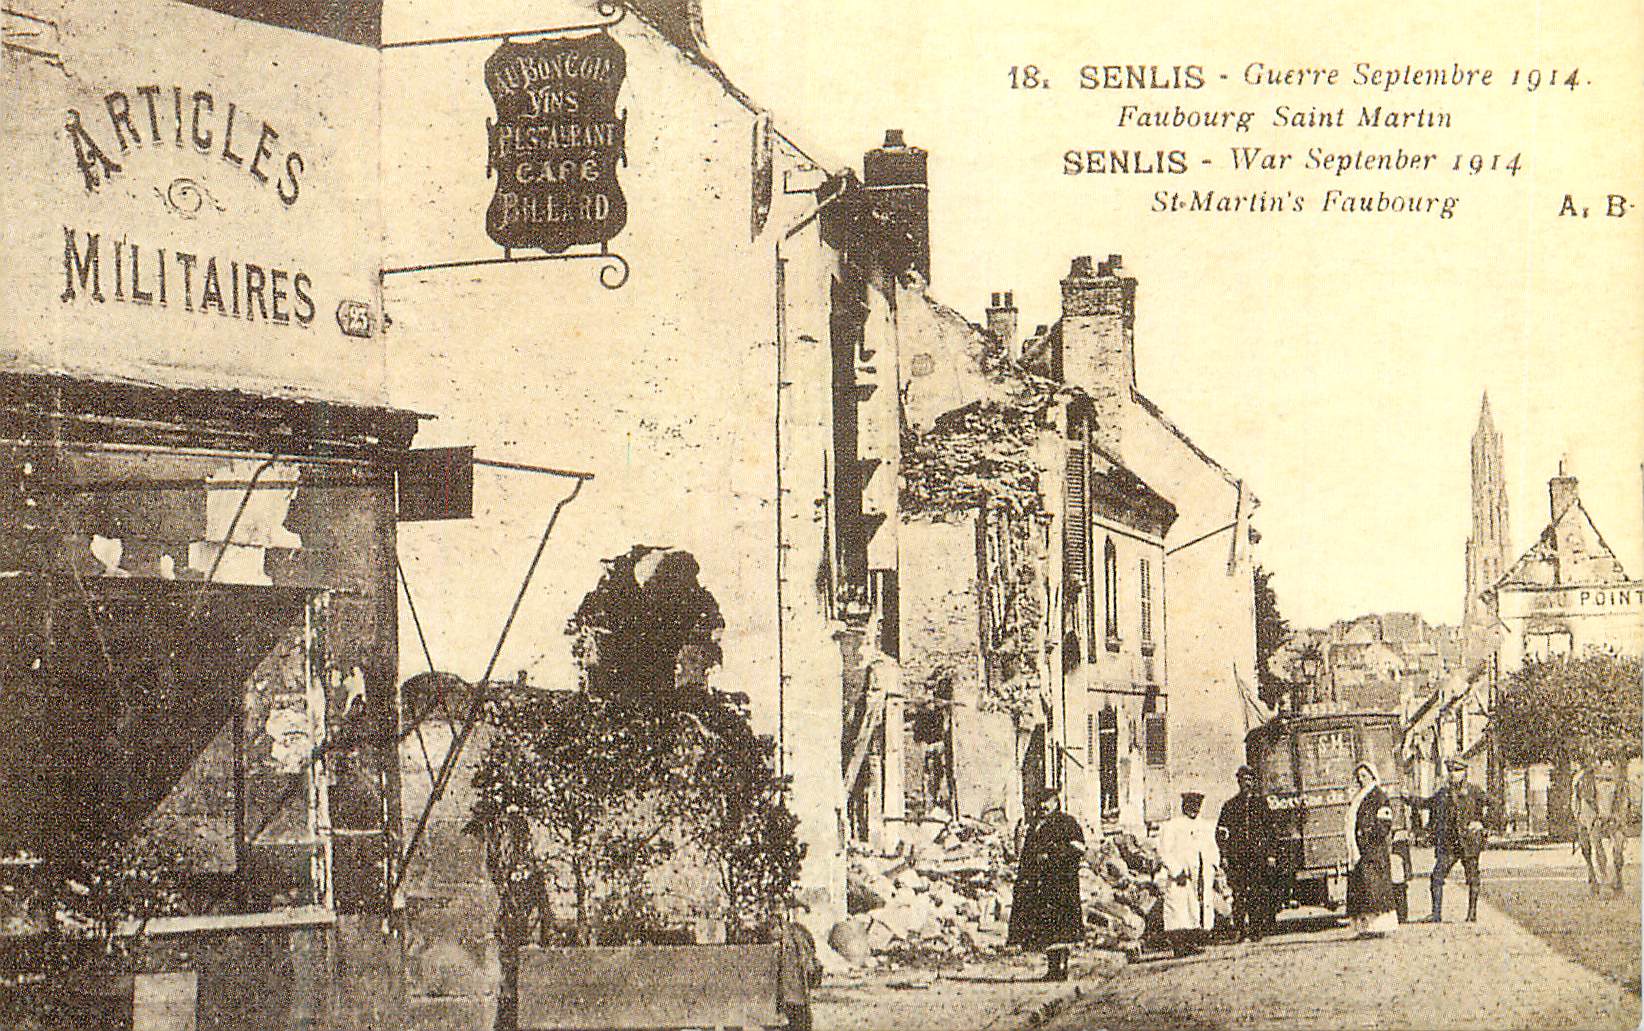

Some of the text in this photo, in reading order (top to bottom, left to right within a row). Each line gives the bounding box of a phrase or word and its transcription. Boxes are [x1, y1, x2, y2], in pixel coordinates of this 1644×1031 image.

[517, 85, 579, 118] VINS
[63, 84, 306, 207] ARTICLES
[494, 189, 610, 230] BILLARD
[59, 224, 317, 327] MILITAIRES
[1579, 590, 1644, 606] POINT
